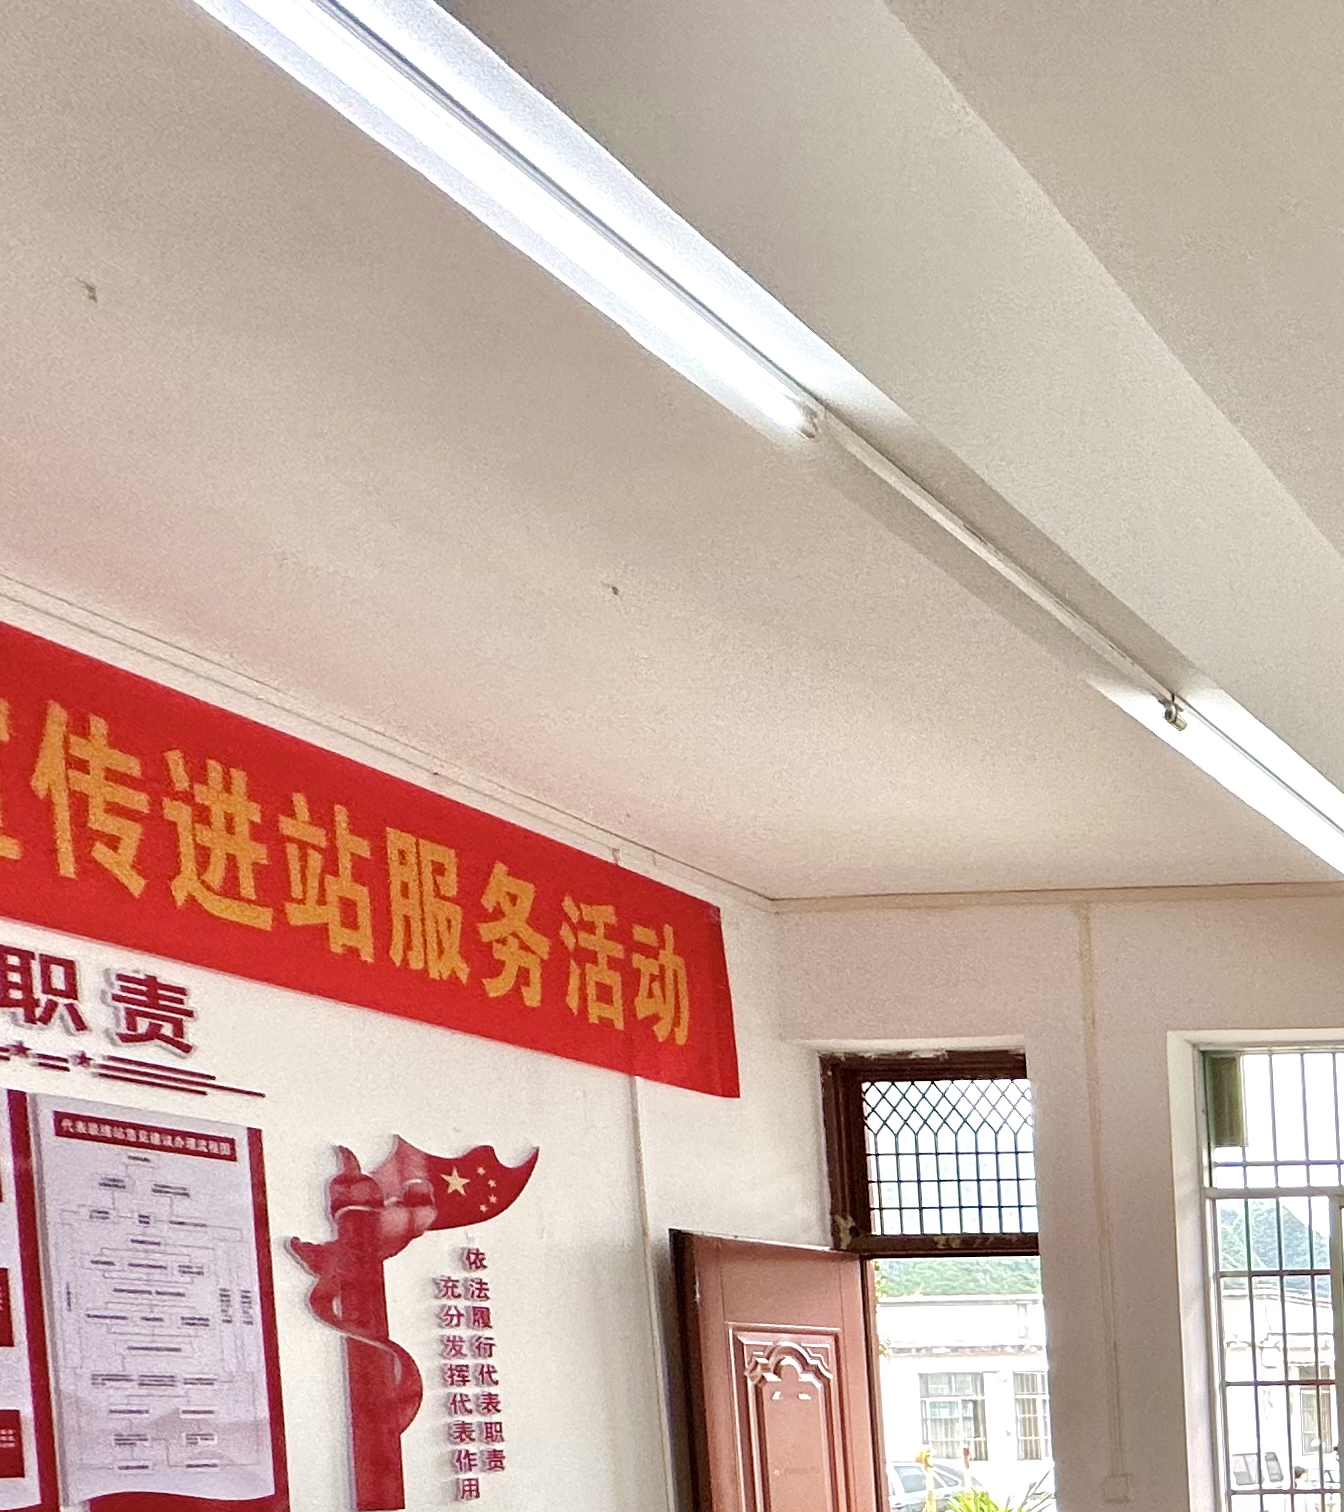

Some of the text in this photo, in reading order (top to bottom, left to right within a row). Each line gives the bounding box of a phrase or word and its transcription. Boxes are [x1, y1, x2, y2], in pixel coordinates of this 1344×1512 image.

[0, 697, 690, 1046] 传进站服务活动
[0, 944, 194, 1053] 职责
[440, 1276, 480, 1499] 充分发挥代表作用
[465, 1248, 505, 1471] 依法履行代表职责
